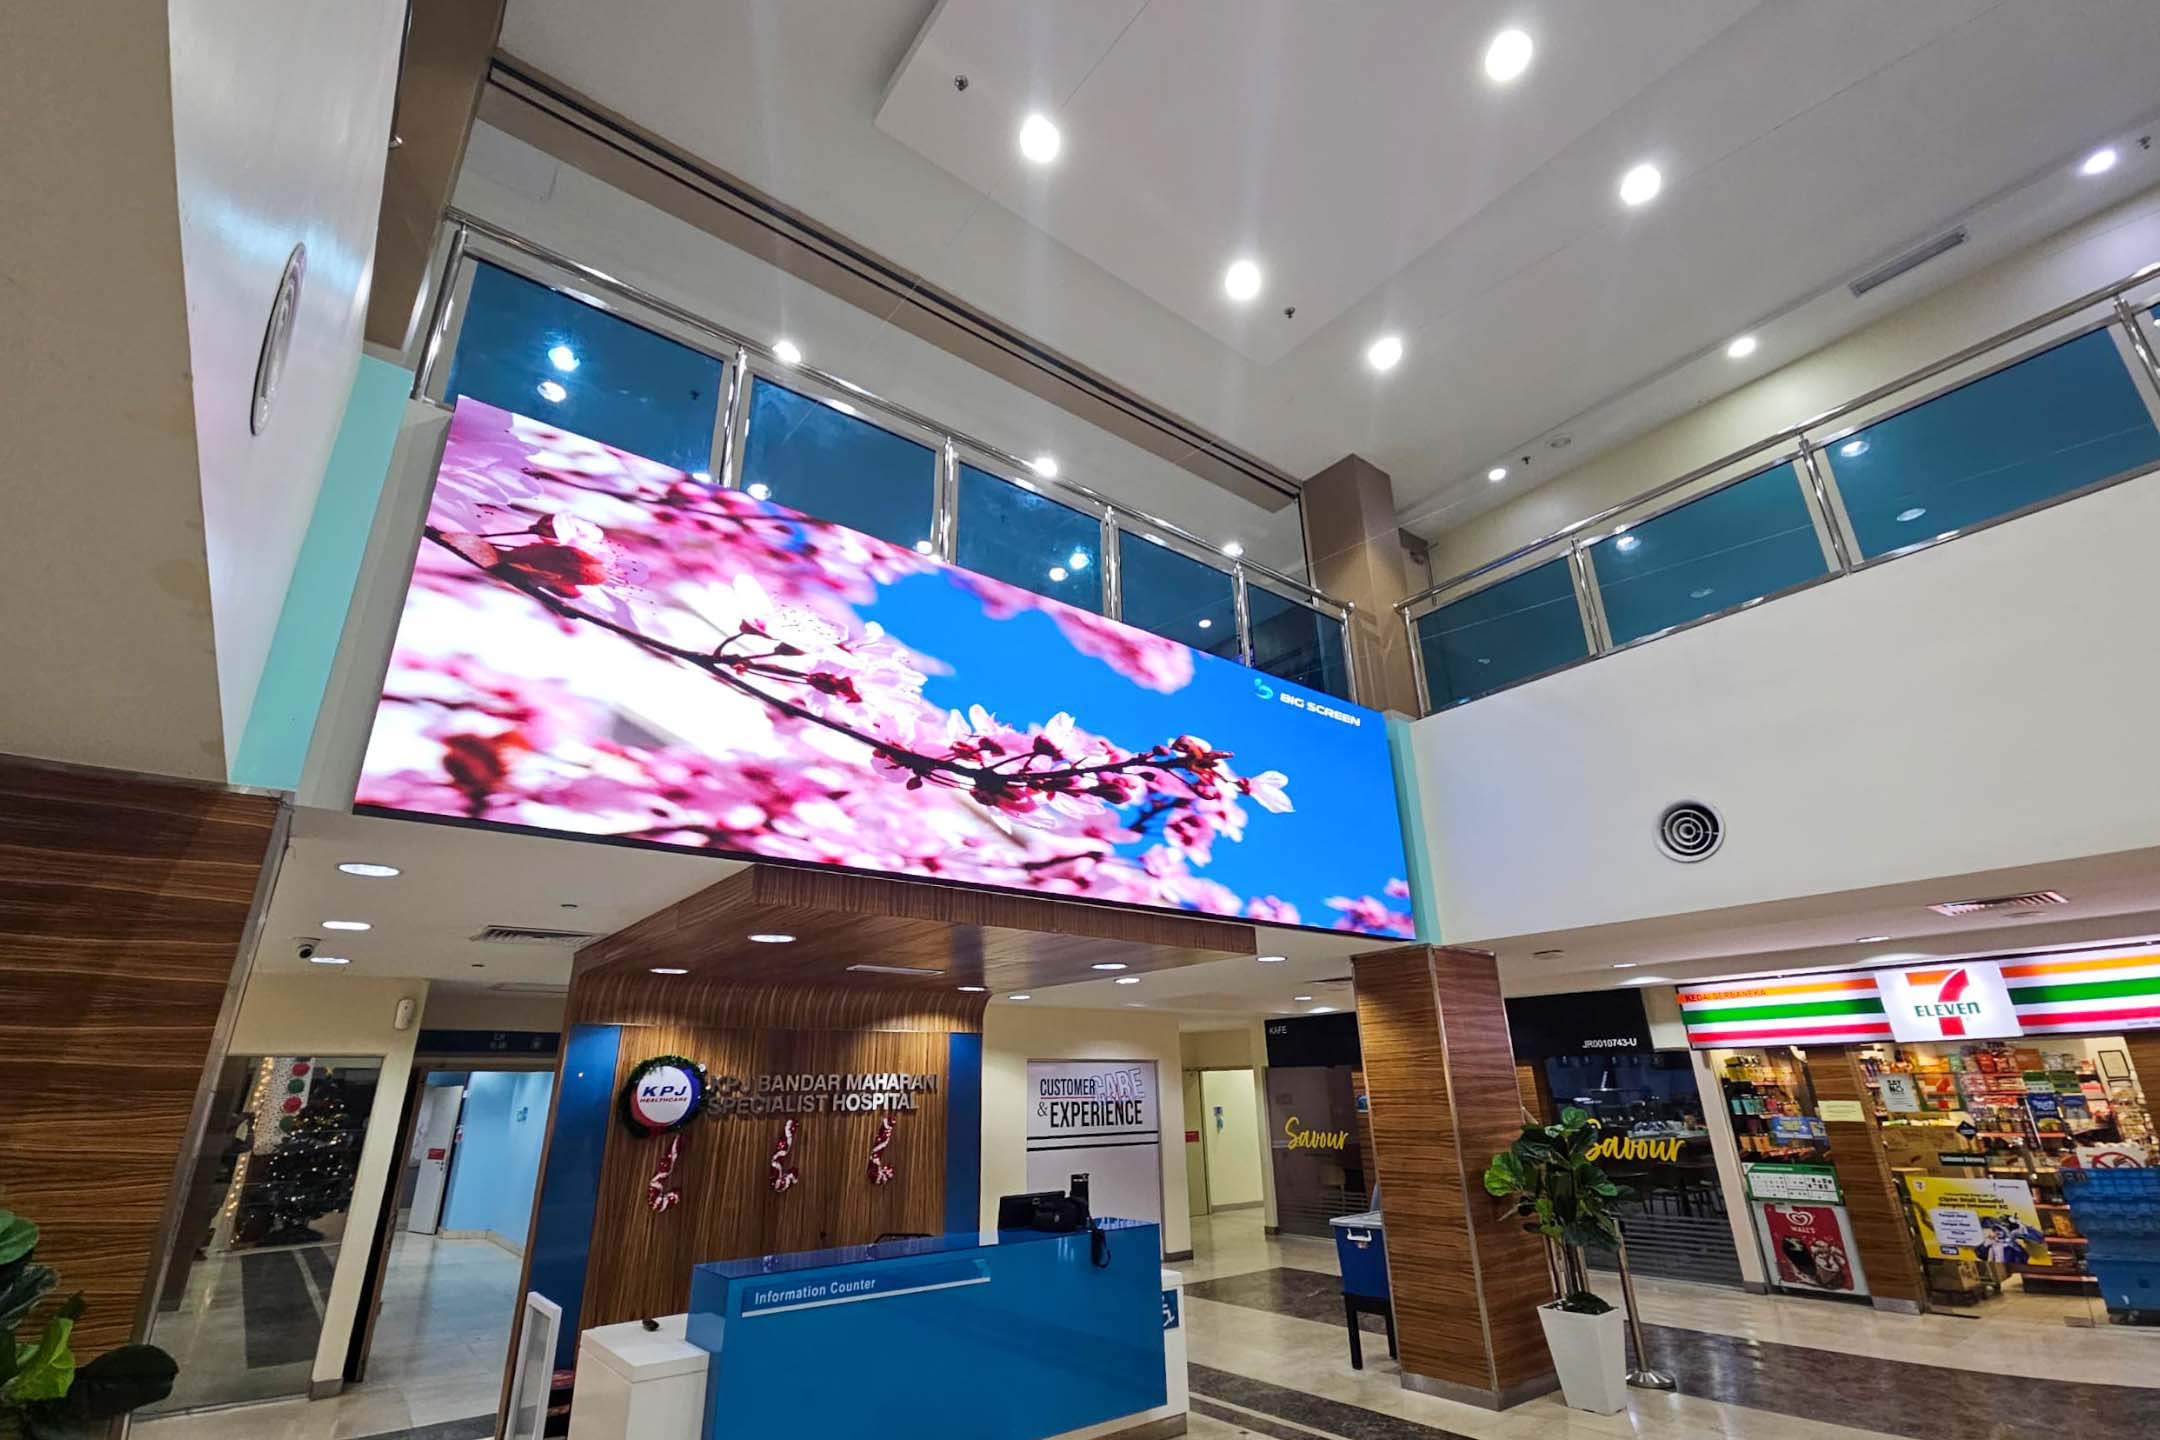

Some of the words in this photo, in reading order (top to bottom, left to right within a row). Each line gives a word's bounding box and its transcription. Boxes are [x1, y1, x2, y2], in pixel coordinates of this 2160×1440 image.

[1280, 692, 1305, 708] BIG
[1306, 701, 1361, 727] SCREEN
[1905, 968, 1969, 1036] 7
[643, 1085, 687, 1097] KPJ
[759, 1073, 842, 1092] BANDAR
[846, 1072, 938, 1092] MAHARANI
[1040, 1078, 1096, 1096] CUSTOMER
[1091, 1067, 1145, 1101] CARE
[706, 1094, 828, 1115] SPECIALIST
[832, 1092, 920, 1112] HOSPITAL
[1037, 1101, 1048, 1117] &
[1050, 1100, 1144, 1128] EXPERIENCE
[1285, 1116, 1349, 1150] Savour
[755, 1285, 826, 1305] Information
[830, 1279, 876, 1295] Counter
